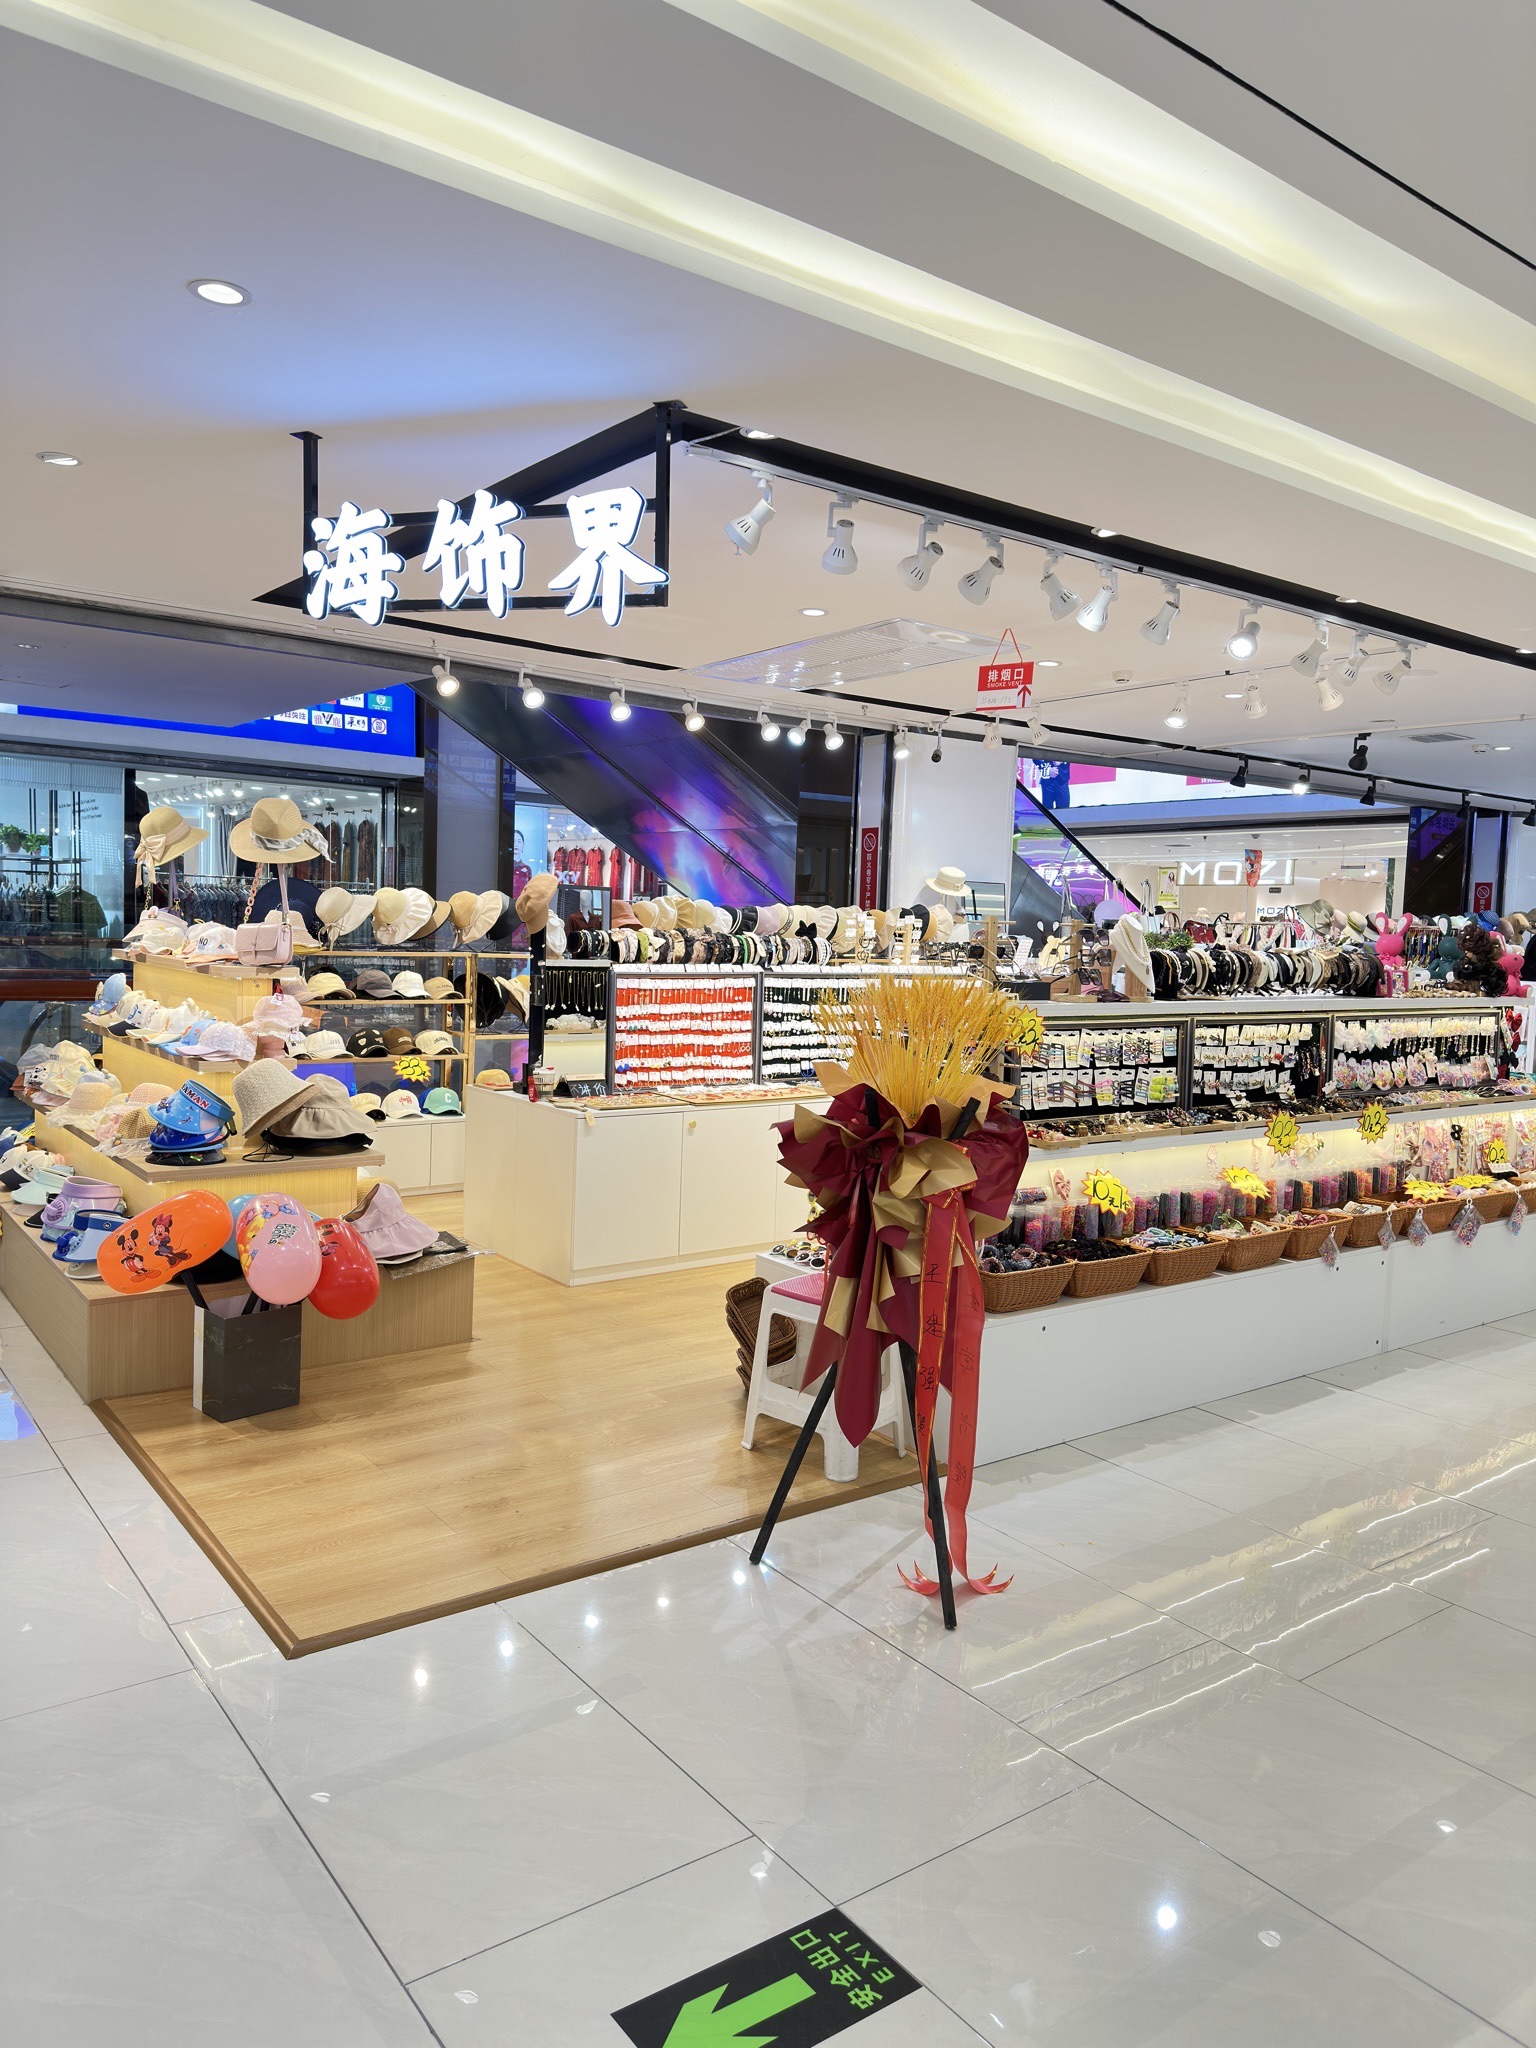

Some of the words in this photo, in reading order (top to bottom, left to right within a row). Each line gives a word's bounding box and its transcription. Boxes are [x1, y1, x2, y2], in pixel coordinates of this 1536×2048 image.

[303, 487, 670, 628] 海饰界
[987, 668, 1024, 682] 排烟口
[1180, 860, 1293, 885] MOZI
[444, 1093, 452, 1104] C
[790, 1928, 883, 2010] 安全出口
[829, 1929, 895, 1984] EXIT
